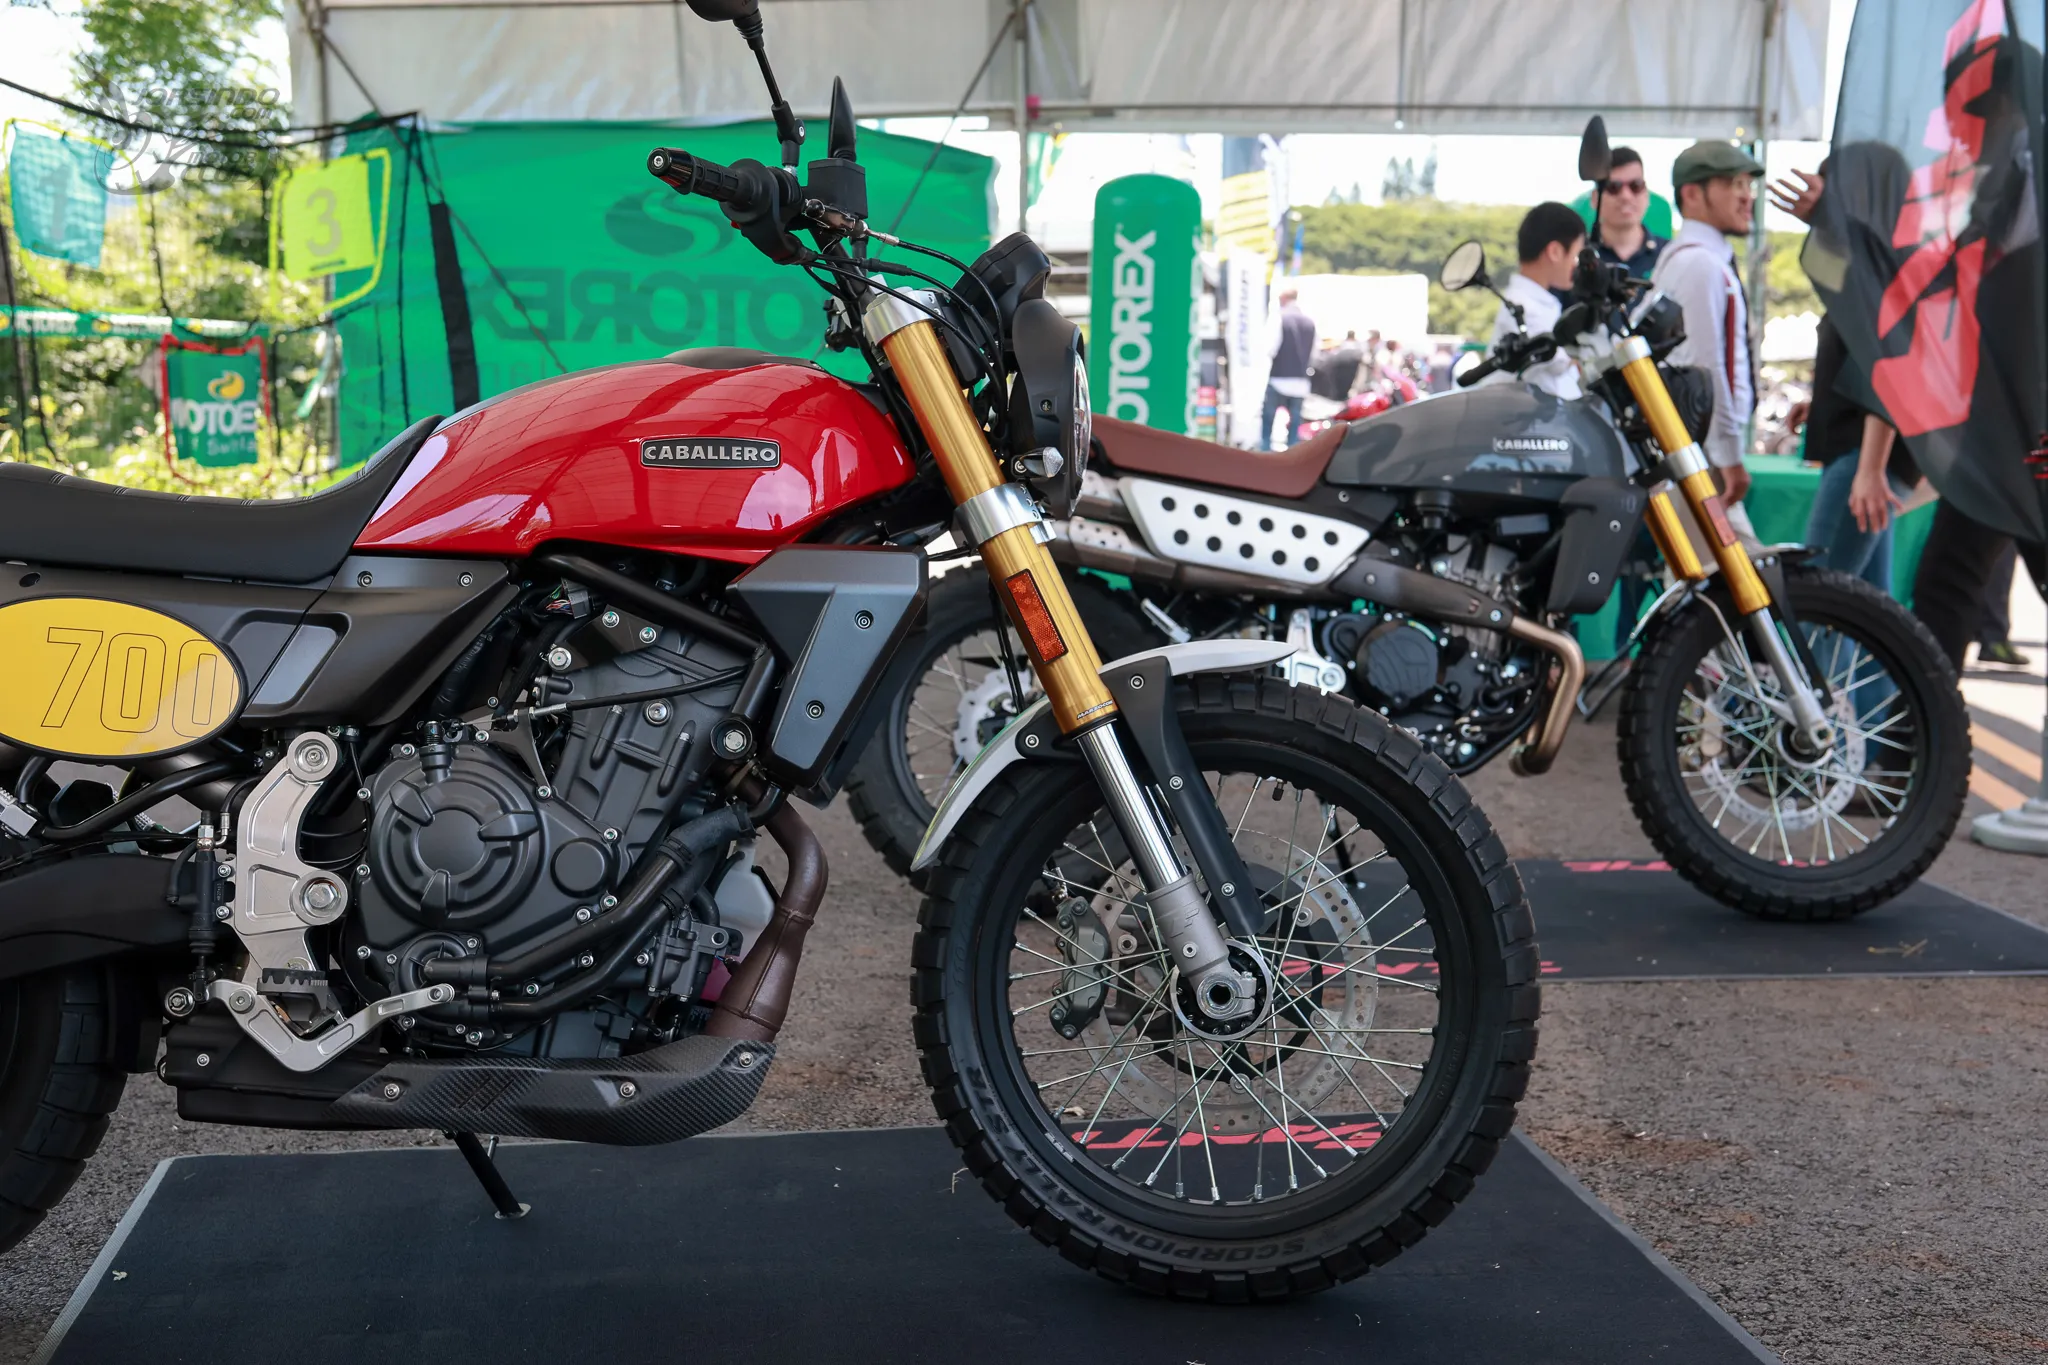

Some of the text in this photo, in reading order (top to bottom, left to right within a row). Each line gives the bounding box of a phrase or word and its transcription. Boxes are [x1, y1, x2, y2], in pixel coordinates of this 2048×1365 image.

[306, 187, 343, 258] 3
[1106, 230, 1157, 425] OTOREX
[644, 445, 776, 462] CABALLERO
[1495, 438, 1570, 451] CABALLERO
[40, 626, 238, 738] 700
[966, 1066, 1010, 1134] STR
[1004, 1144, 1106, 1224] RALLY
[1108, 1223, 1304, 1263] SCORPION
